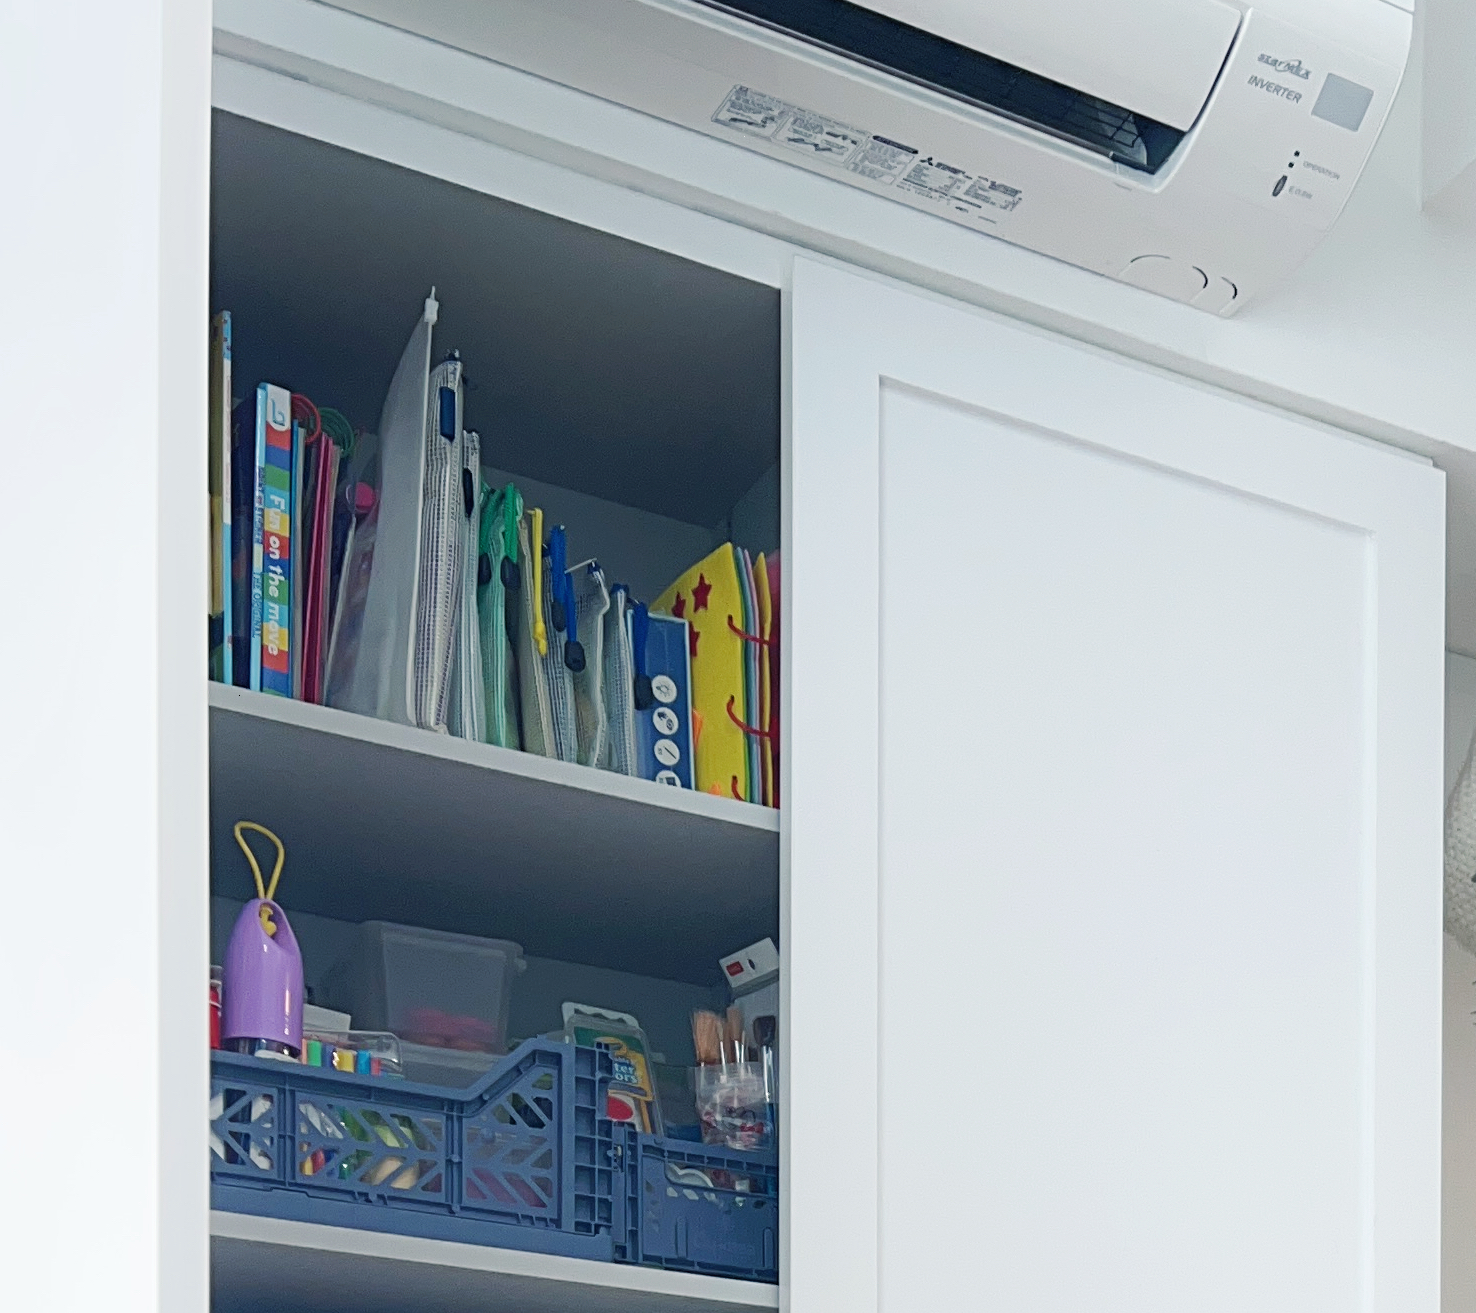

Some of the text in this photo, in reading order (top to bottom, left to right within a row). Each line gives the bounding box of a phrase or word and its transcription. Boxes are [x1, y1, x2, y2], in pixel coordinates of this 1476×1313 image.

[1247, 74, 1303, 104] INVERTER
[267, 493, 286, 657] Fun on the move
